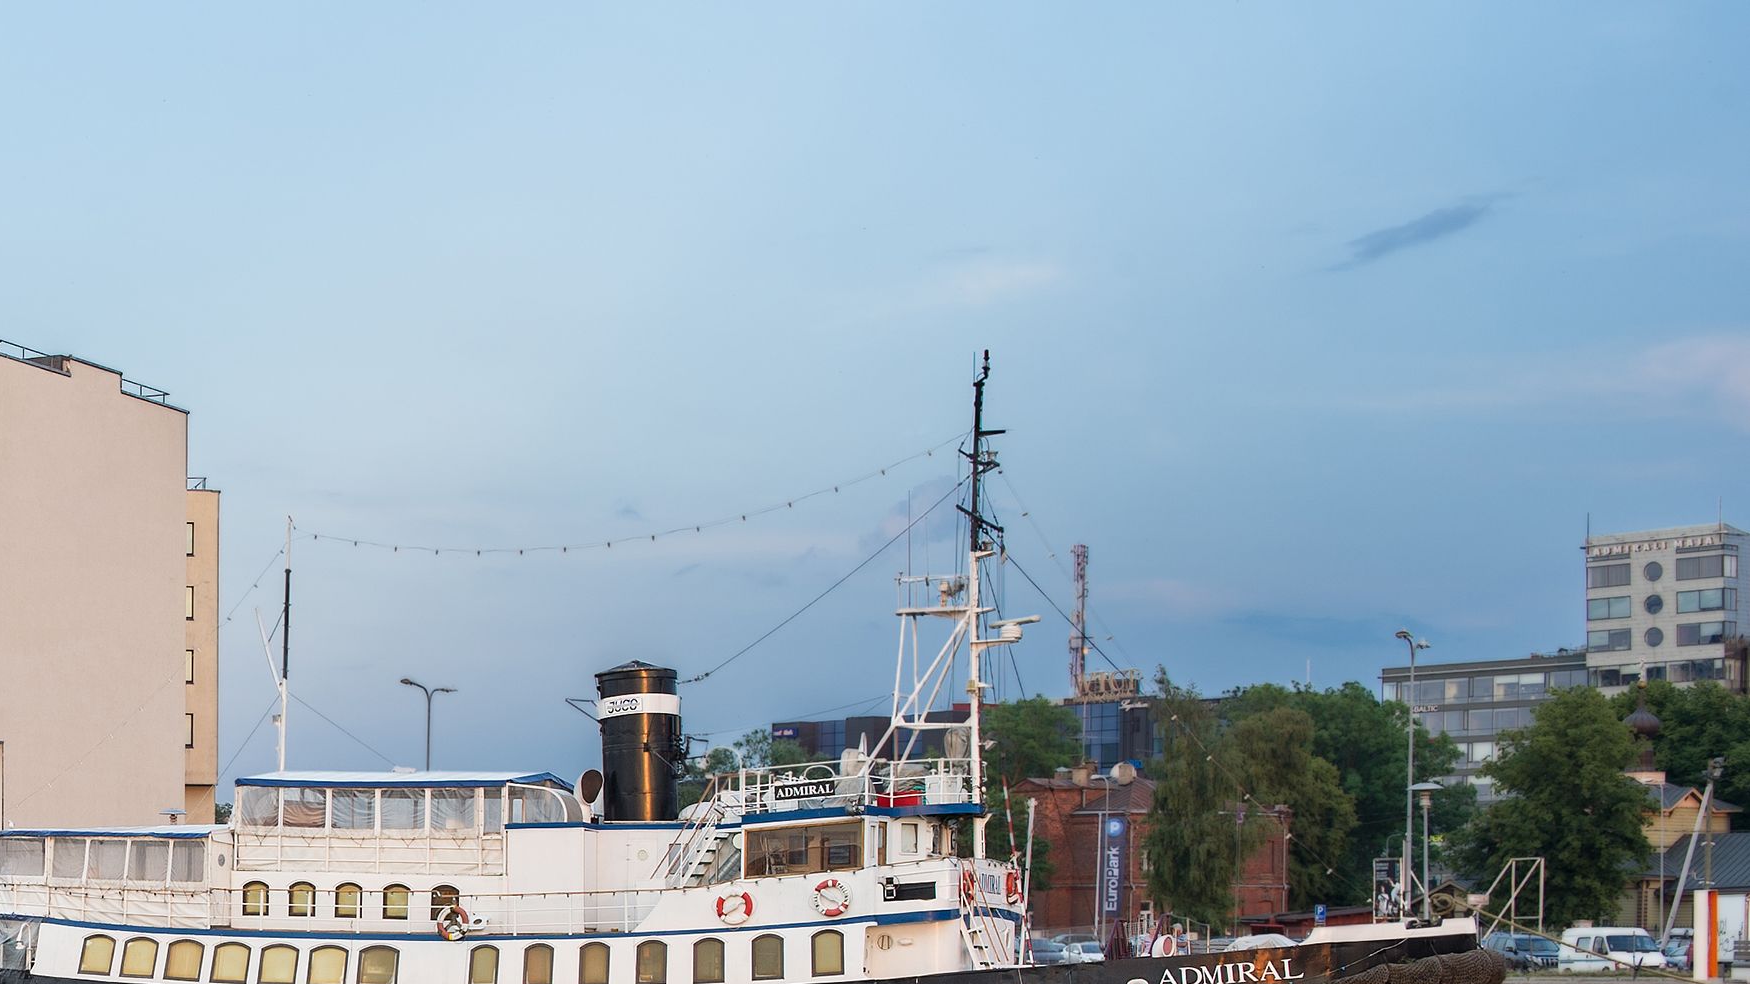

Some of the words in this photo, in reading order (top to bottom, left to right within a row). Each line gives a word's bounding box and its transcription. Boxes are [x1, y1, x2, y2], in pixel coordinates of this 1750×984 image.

[1674, 537, 1715, 549] MAJA
[776, 783, 834, 799] ADMIRAL
[1106, 846, 1120, 911] EuroPark
